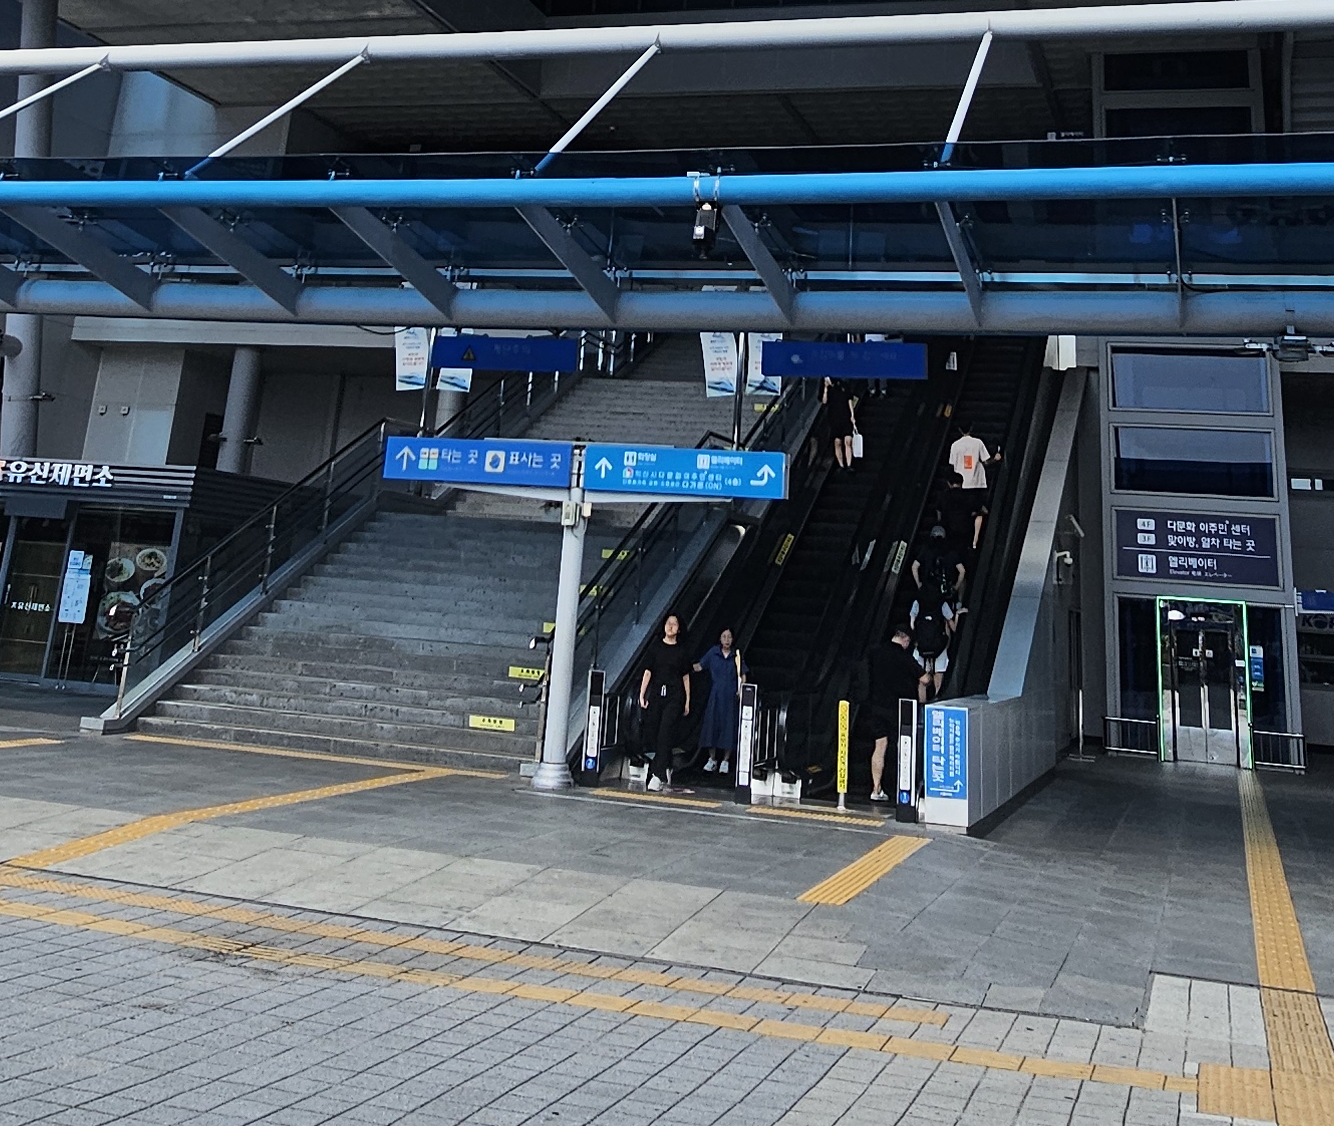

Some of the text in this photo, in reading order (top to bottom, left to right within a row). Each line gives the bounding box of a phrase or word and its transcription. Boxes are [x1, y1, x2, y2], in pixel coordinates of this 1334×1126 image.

[441, 448, 478, 464] 타는 곳
[509, 452, 561, 469] 표사는 곳
[8, 461, 114, 488] 유신제면소
[1167, 520, 1196, 533] 다문화
[1231, 524, 1250, 536] 센터
[1202, 537, 1220, 549] 열차
[1223, 538, 1242, 550] 타는
[1246, 539, 1255, 552] 곳
[1168, 556, 1217, 570] 엘리베이터
